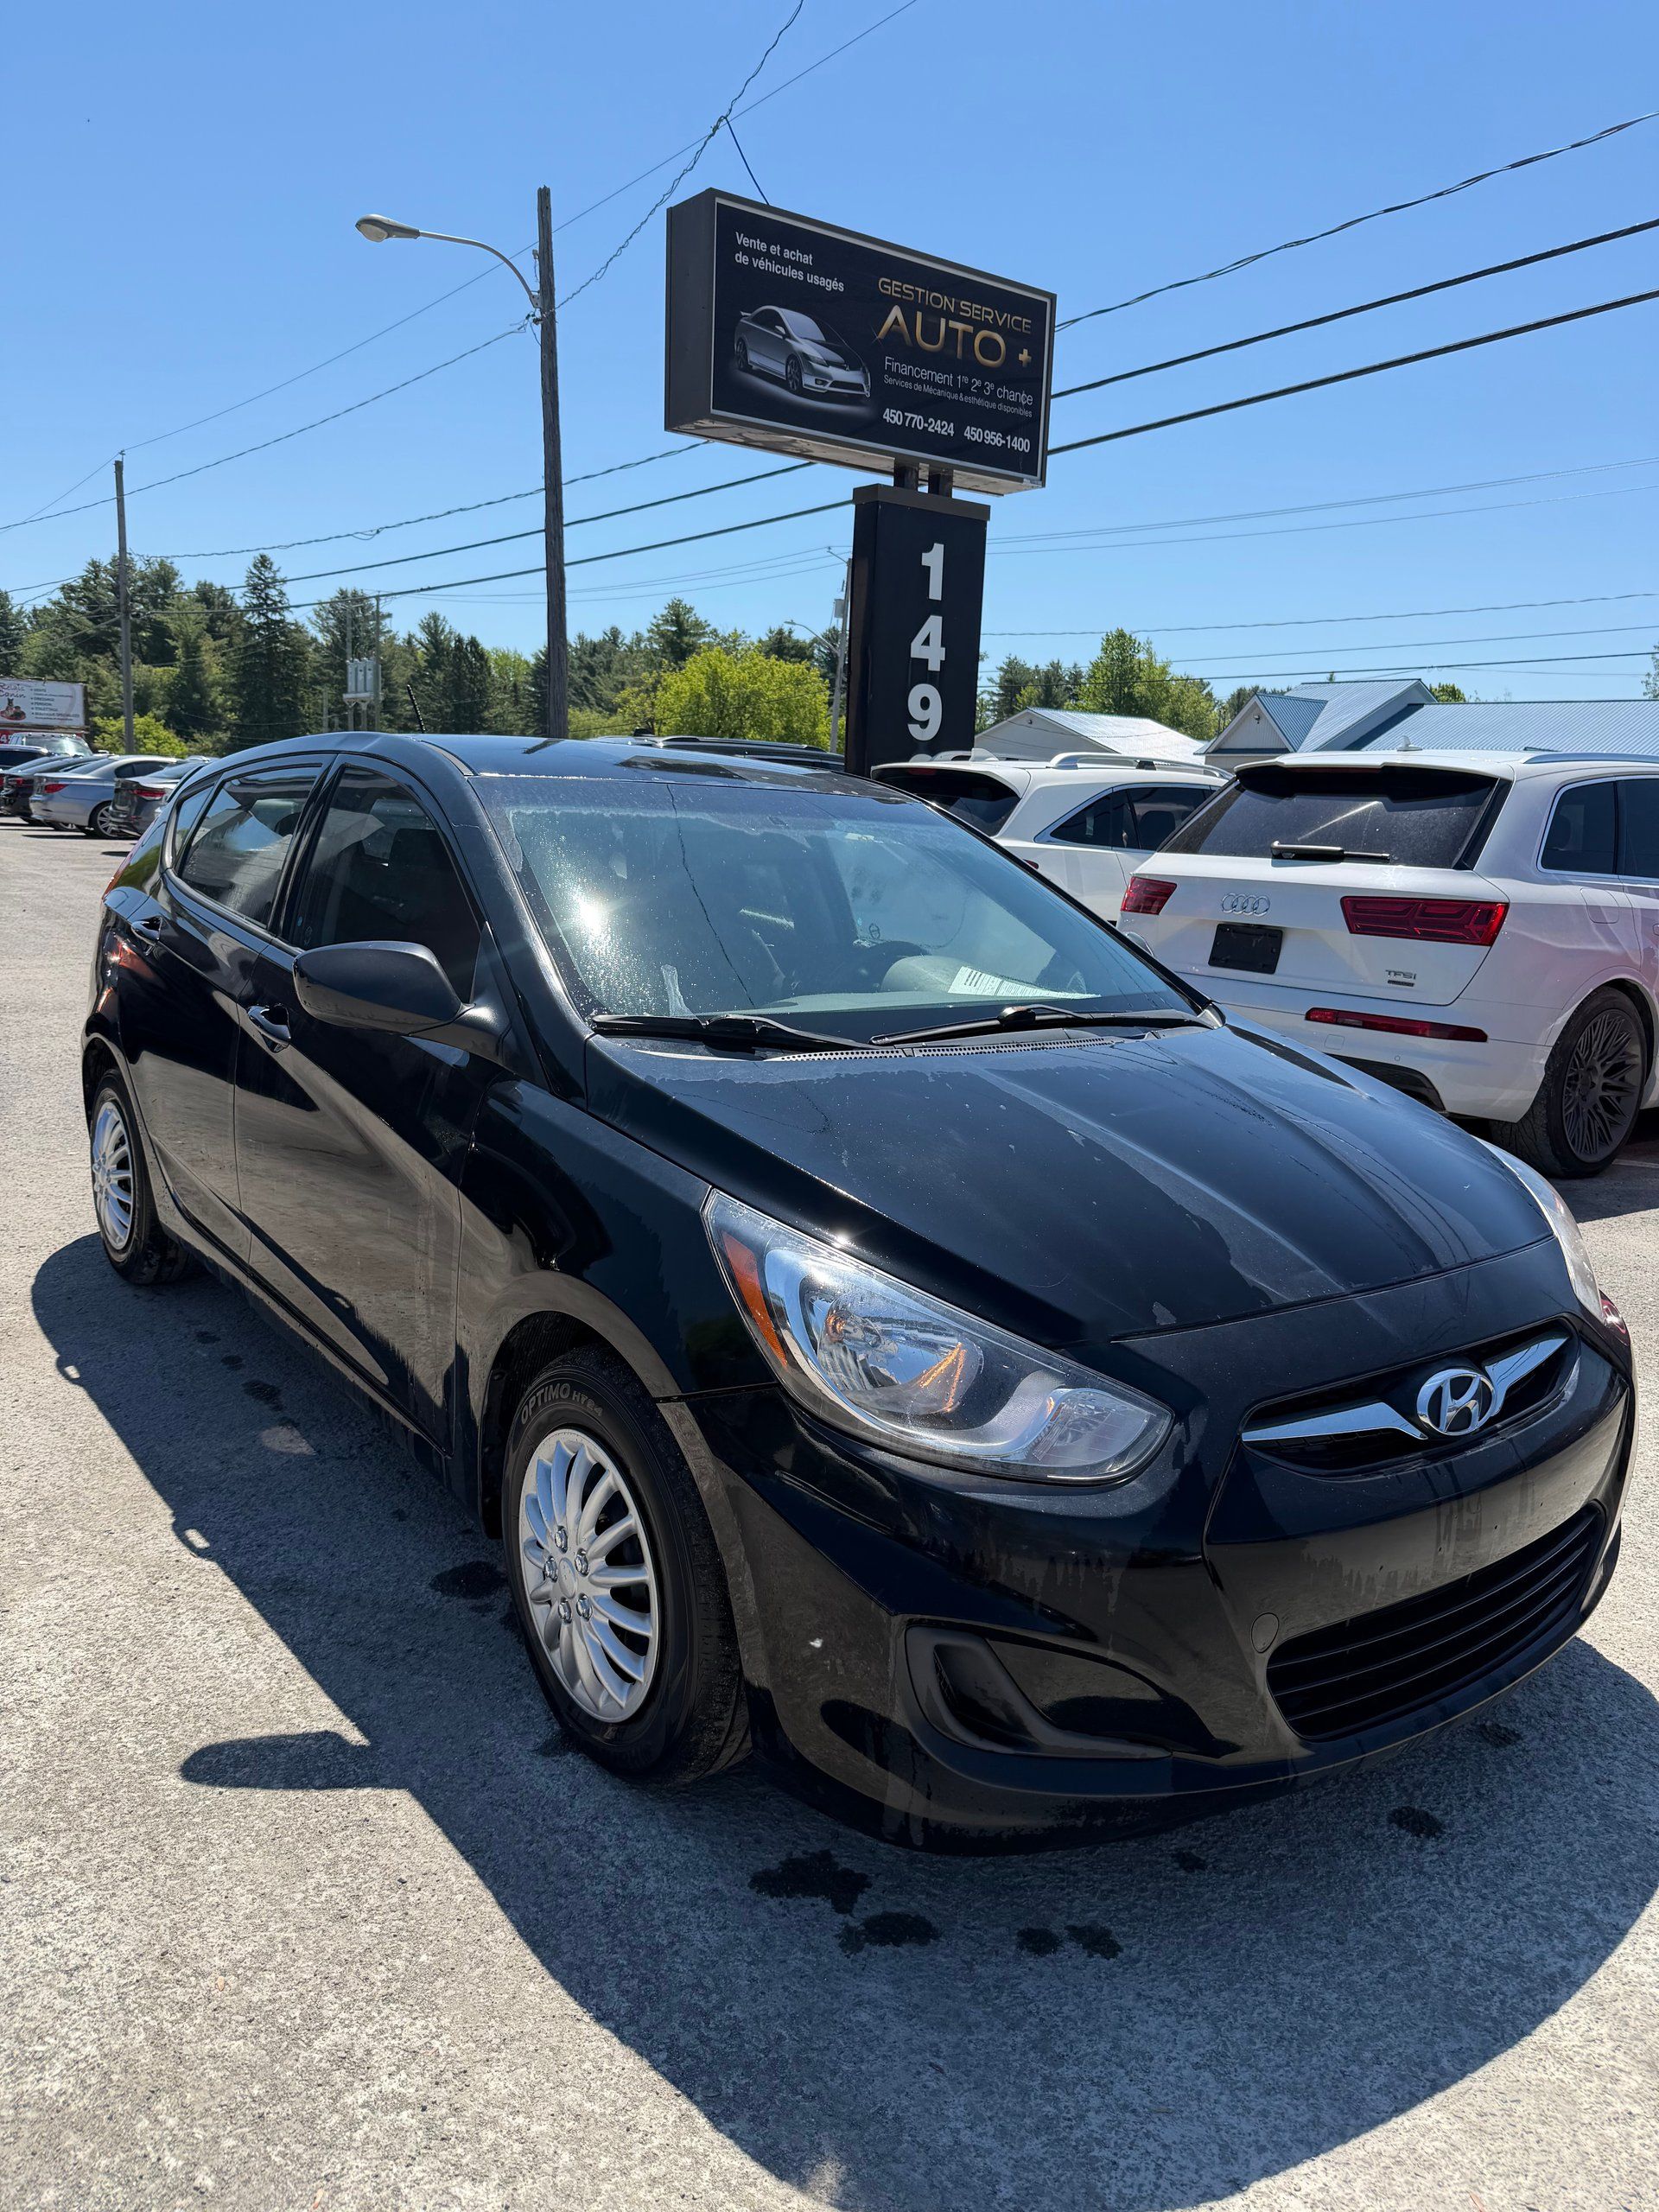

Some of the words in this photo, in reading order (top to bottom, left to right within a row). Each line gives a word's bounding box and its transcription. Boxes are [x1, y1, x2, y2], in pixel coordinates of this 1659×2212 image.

[735, 232, 767, 252] Vente
[770, 244, 780, 256] et
[783, 249, 813, 265] achat
[734, 251, 749, 265] de
[752, 257, 804, 281] véhicules
[807, 273, 844, 292] usagés
[878, 277, 955, 313] GESTION
[959, 301, 1032, 334] SERVICE
[876, 304, 1007, 368] AUTO
[883, 374, 912, 390] Services
[913, 382, 922, 391] de
[923, 384, 958, 400] Mécanique
[963, 395, 997, 410] esthétique
[997, 403, 1033, 417] disponibles
[885, 356, 953, 387] Financement
[970, 378, 982, 392] 2e
[983, 382, 995, 395] 3e
[996, 385, 1033, 405] chance
[882, 408, 903, 426] 450
[904, 412, 955, 437] 770-2424
[963, 425, 983, 442] 450
[983, 429, 1031, 454] 956-1400
[907, 543, 945, 762] 149
[521, 1382, 571, 1425] OPTIMO
